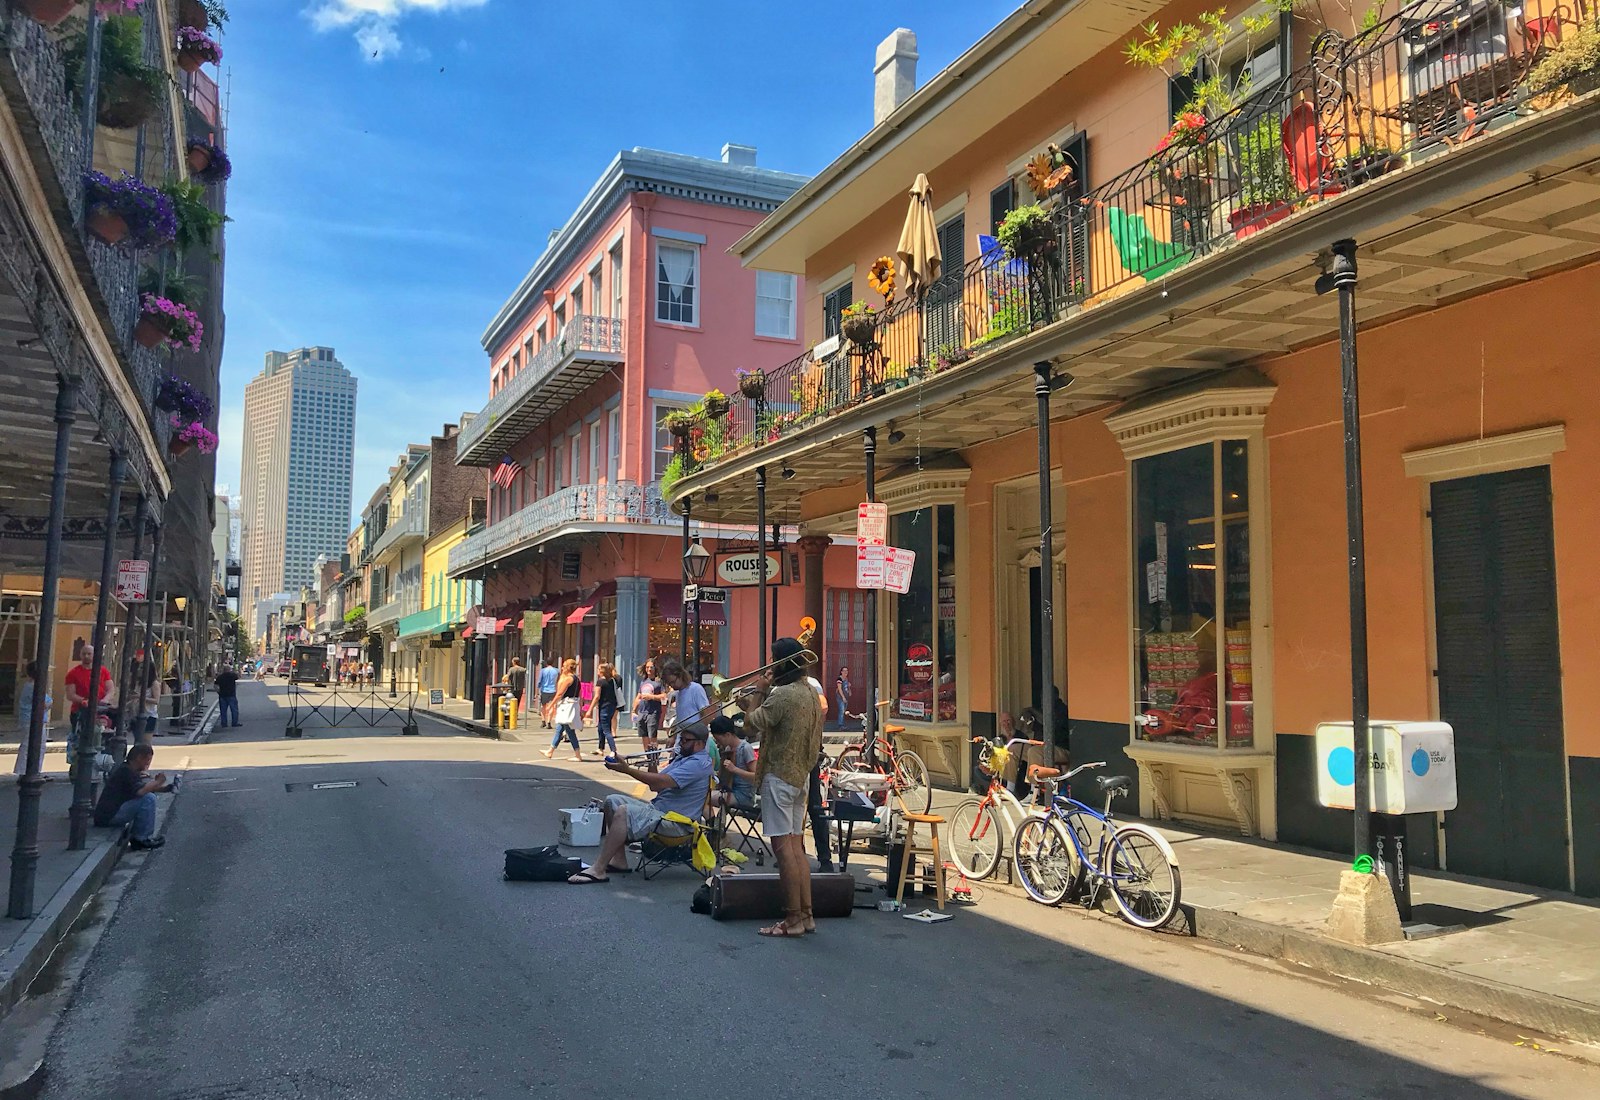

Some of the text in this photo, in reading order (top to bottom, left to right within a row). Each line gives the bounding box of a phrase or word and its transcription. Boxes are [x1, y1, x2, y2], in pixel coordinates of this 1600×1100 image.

[895, 553, 914, 562] PARKING
[120, 562, 130, 571] NO
[886, 563, 911, 571] FREIGHT
[889, 570, 905, 578] ZONE
[704, 592, 724, 601] Peter
